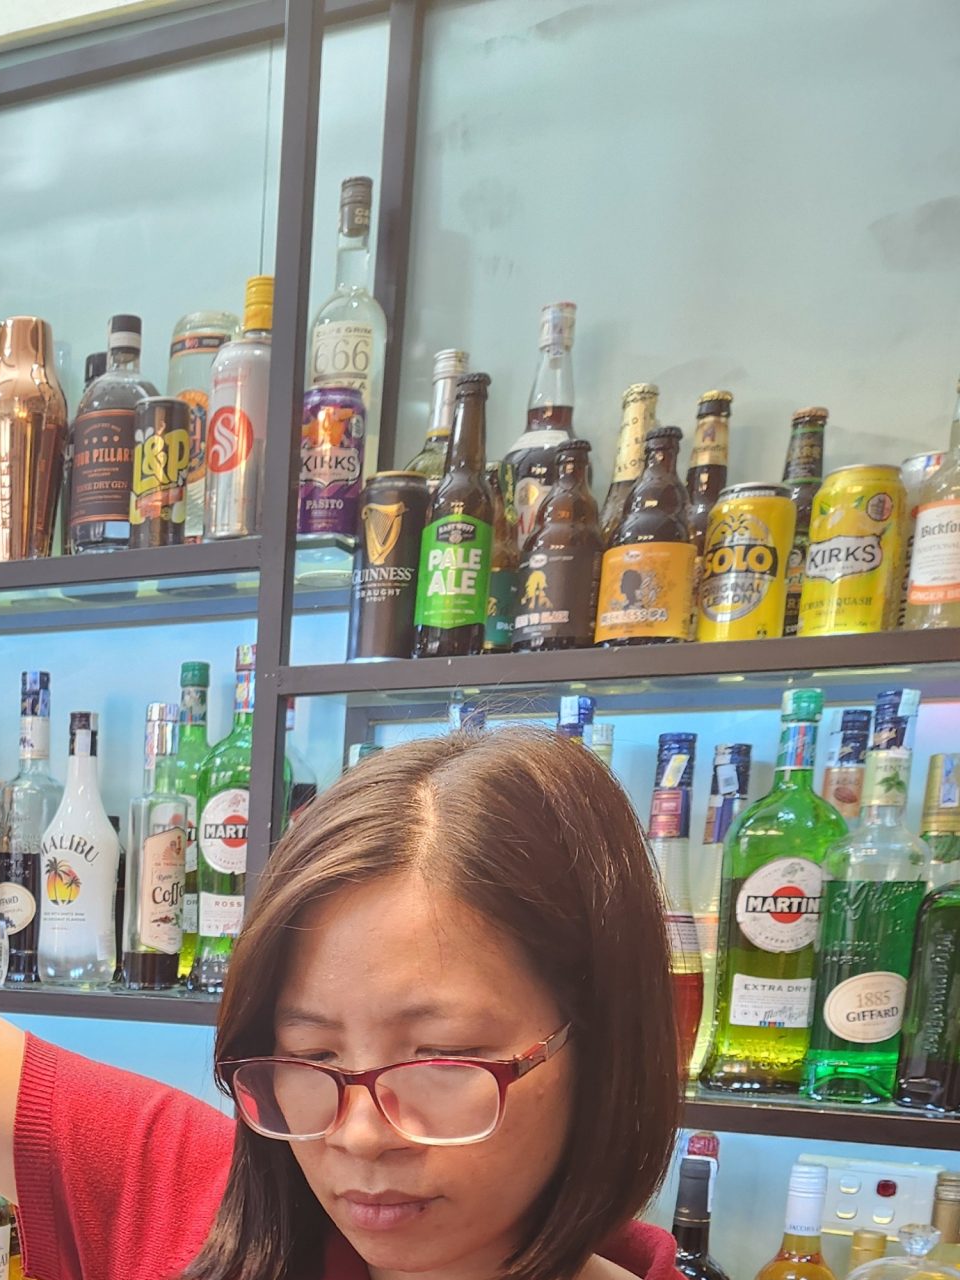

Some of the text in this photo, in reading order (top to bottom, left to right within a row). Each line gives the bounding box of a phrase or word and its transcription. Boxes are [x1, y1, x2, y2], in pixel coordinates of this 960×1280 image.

[313, 339, 368, 374] 666
[132, 429, 189, 497] L&P
[302, 454, 357, 472] KIRKS
[305, 499, 344, 510] PASITO
[427, 547, 482, 571] PALE
[704, 545, 774, 581] SOLO
[809, 543, 877, 571] KIRKS
[352, 566, 415, 585] GUINNESS
[426, 570, 478, 597] ALE
[705, 593, 753, 609] LEMON
[743, 983, 809, 993] EXTRA DRY
[855, 989, 891, 1009] 1885
[845, 1006, 900, 1023] GIFFARD
